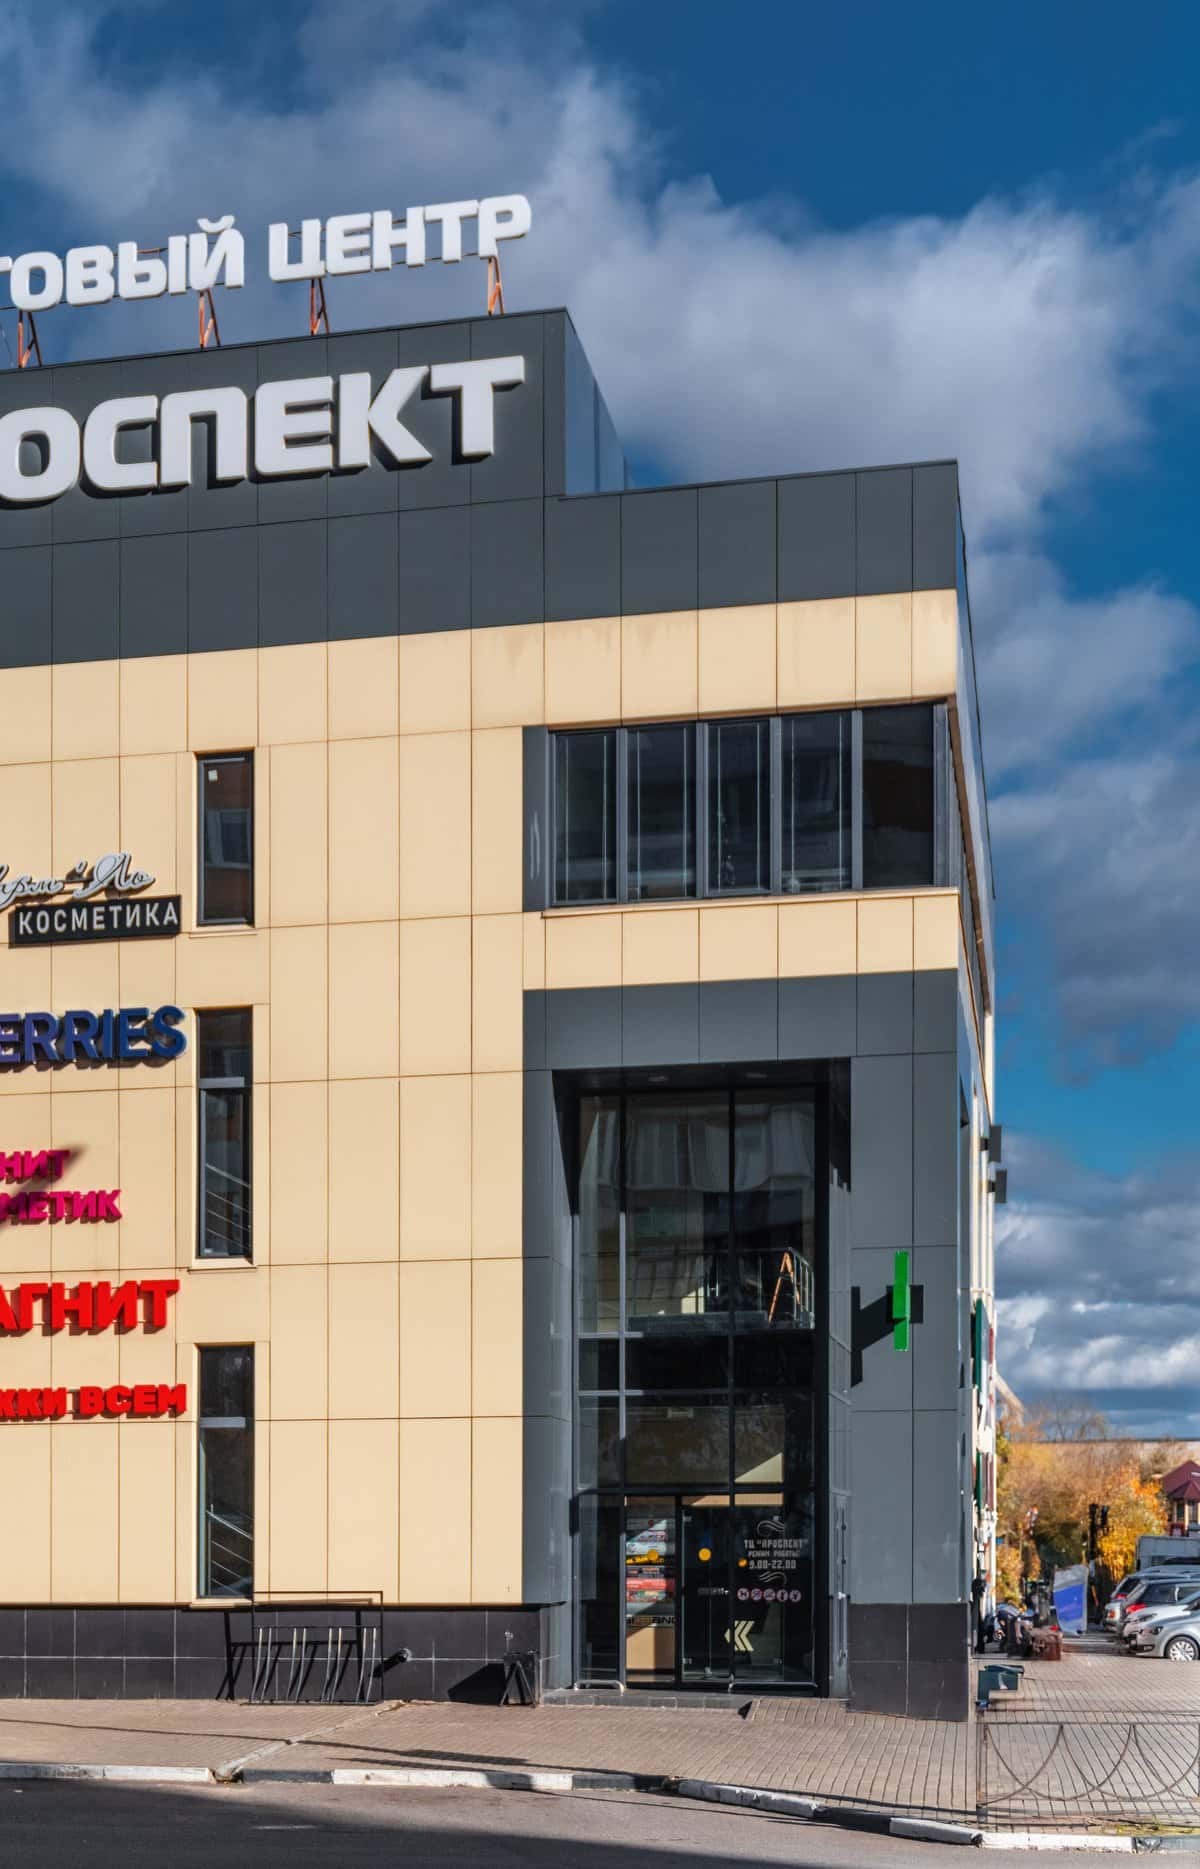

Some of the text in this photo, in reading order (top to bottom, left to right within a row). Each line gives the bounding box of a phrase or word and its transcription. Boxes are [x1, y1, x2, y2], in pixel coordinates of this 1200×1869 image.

[267, 194, 532, 283] ЦЕНТР
[18, 902, 179, 935] КОСМЕТИКА
[79, 1384, 188, 1415] ВСЕМ
